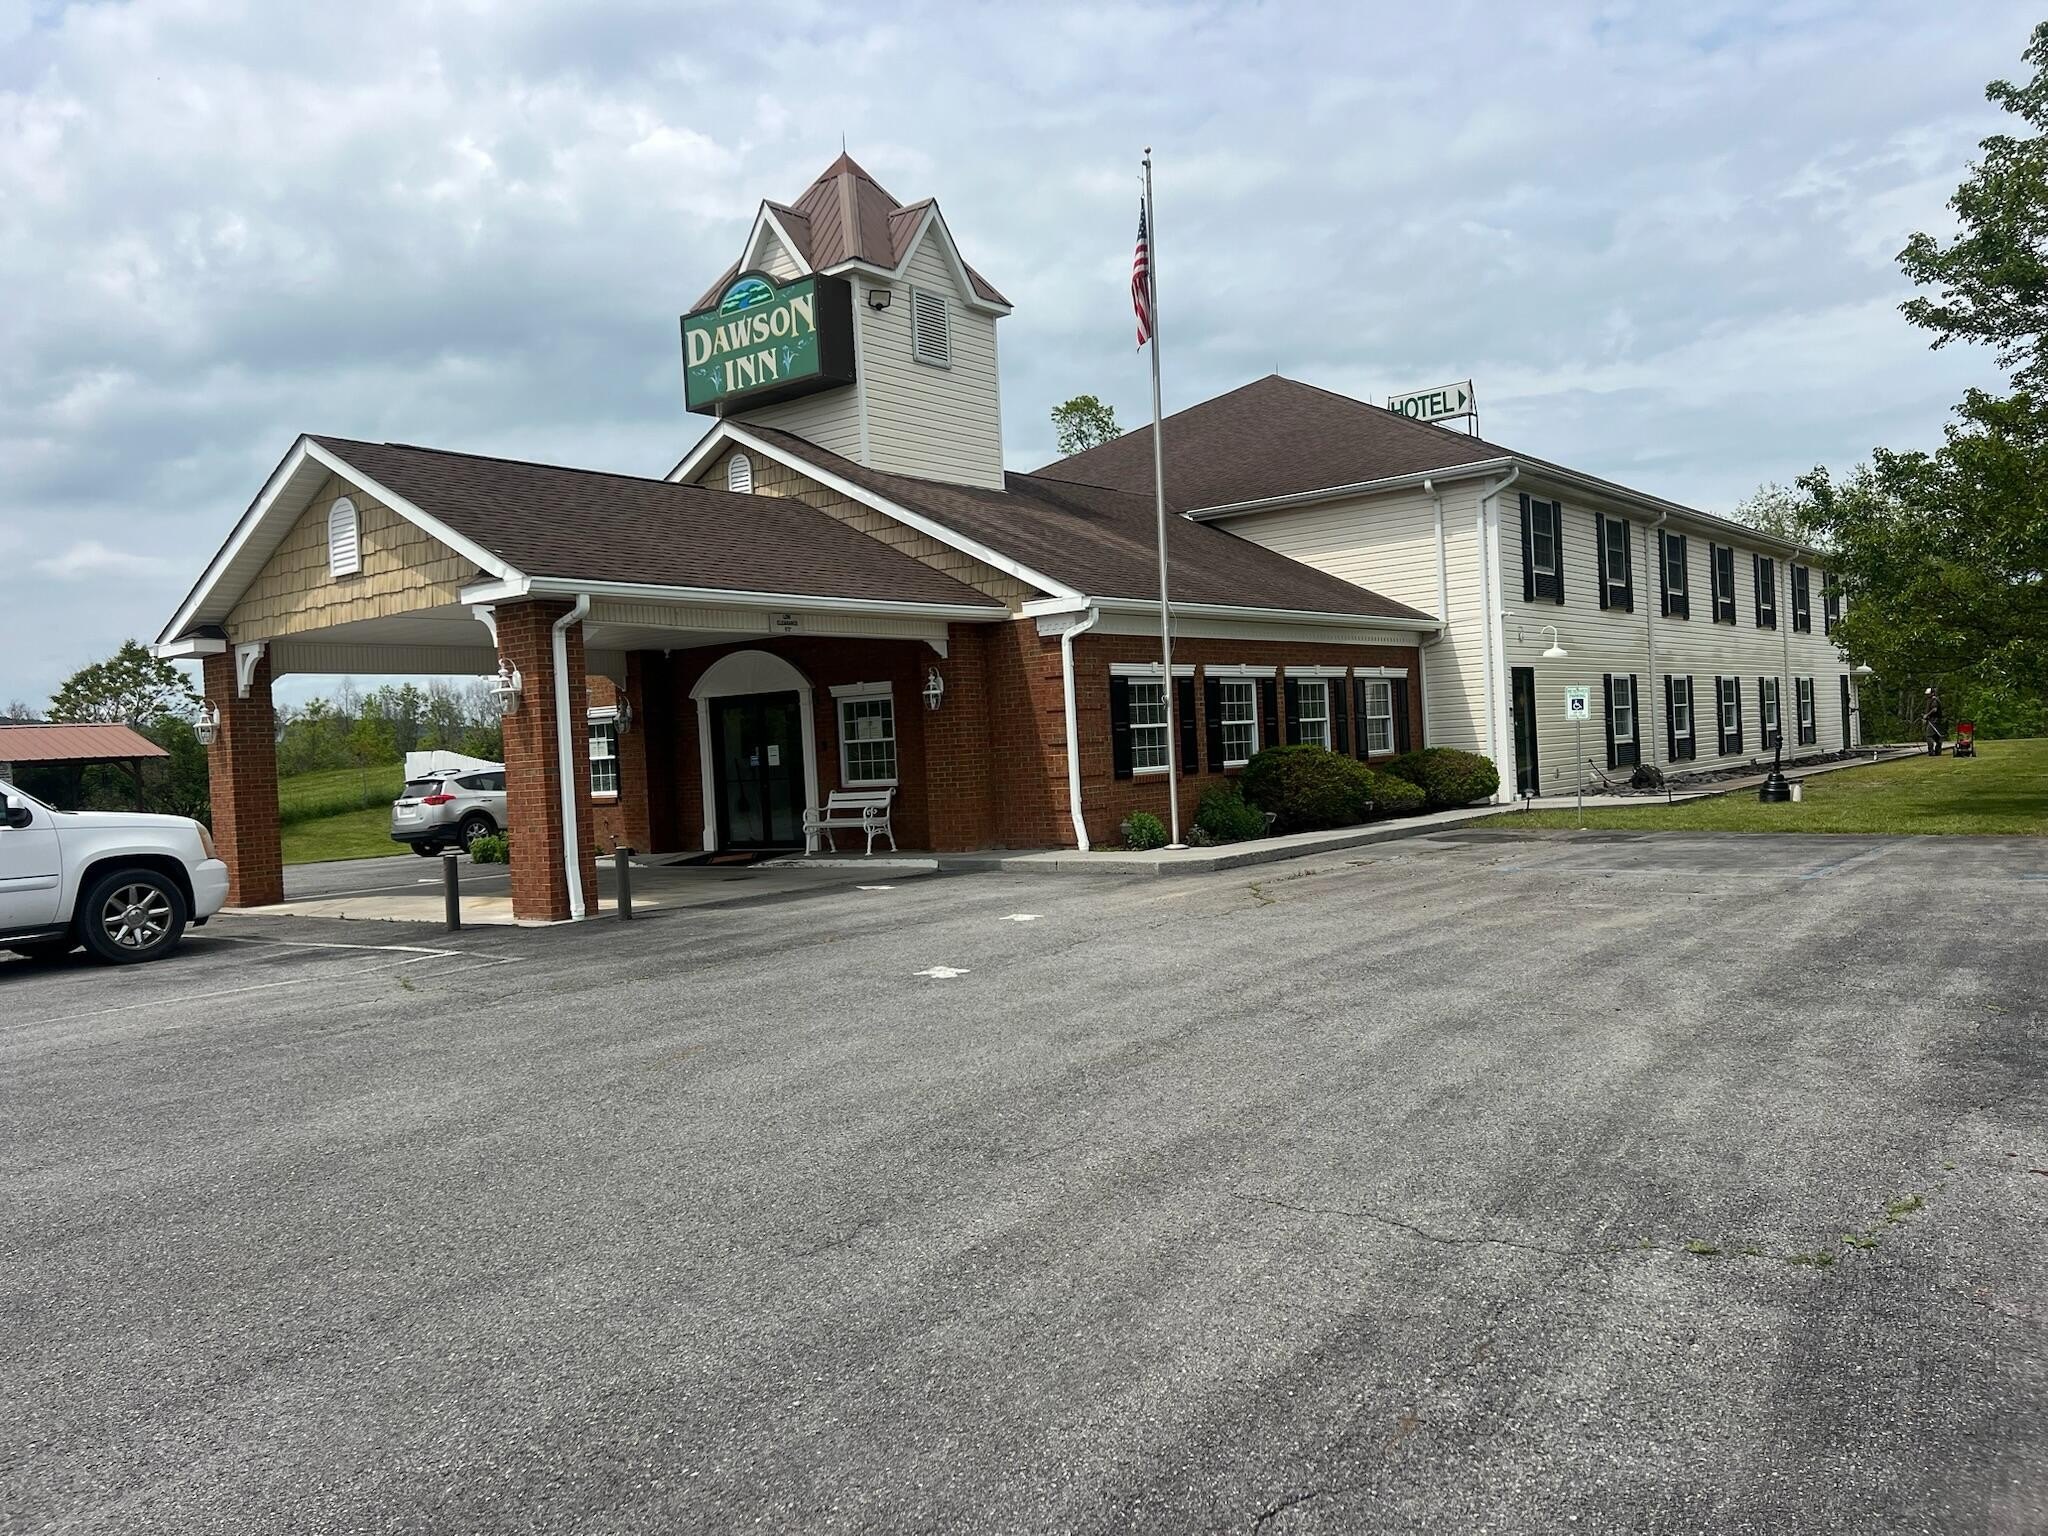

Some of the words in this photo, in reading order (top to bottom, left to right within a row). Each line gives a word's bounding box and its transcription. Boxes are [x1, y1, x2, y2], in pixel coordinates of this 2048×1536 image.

[686, 293, 817, 368] DAWSON
[725, 348, 779, 392] INN
[1391, 391, 1455, 419] HOTEL
